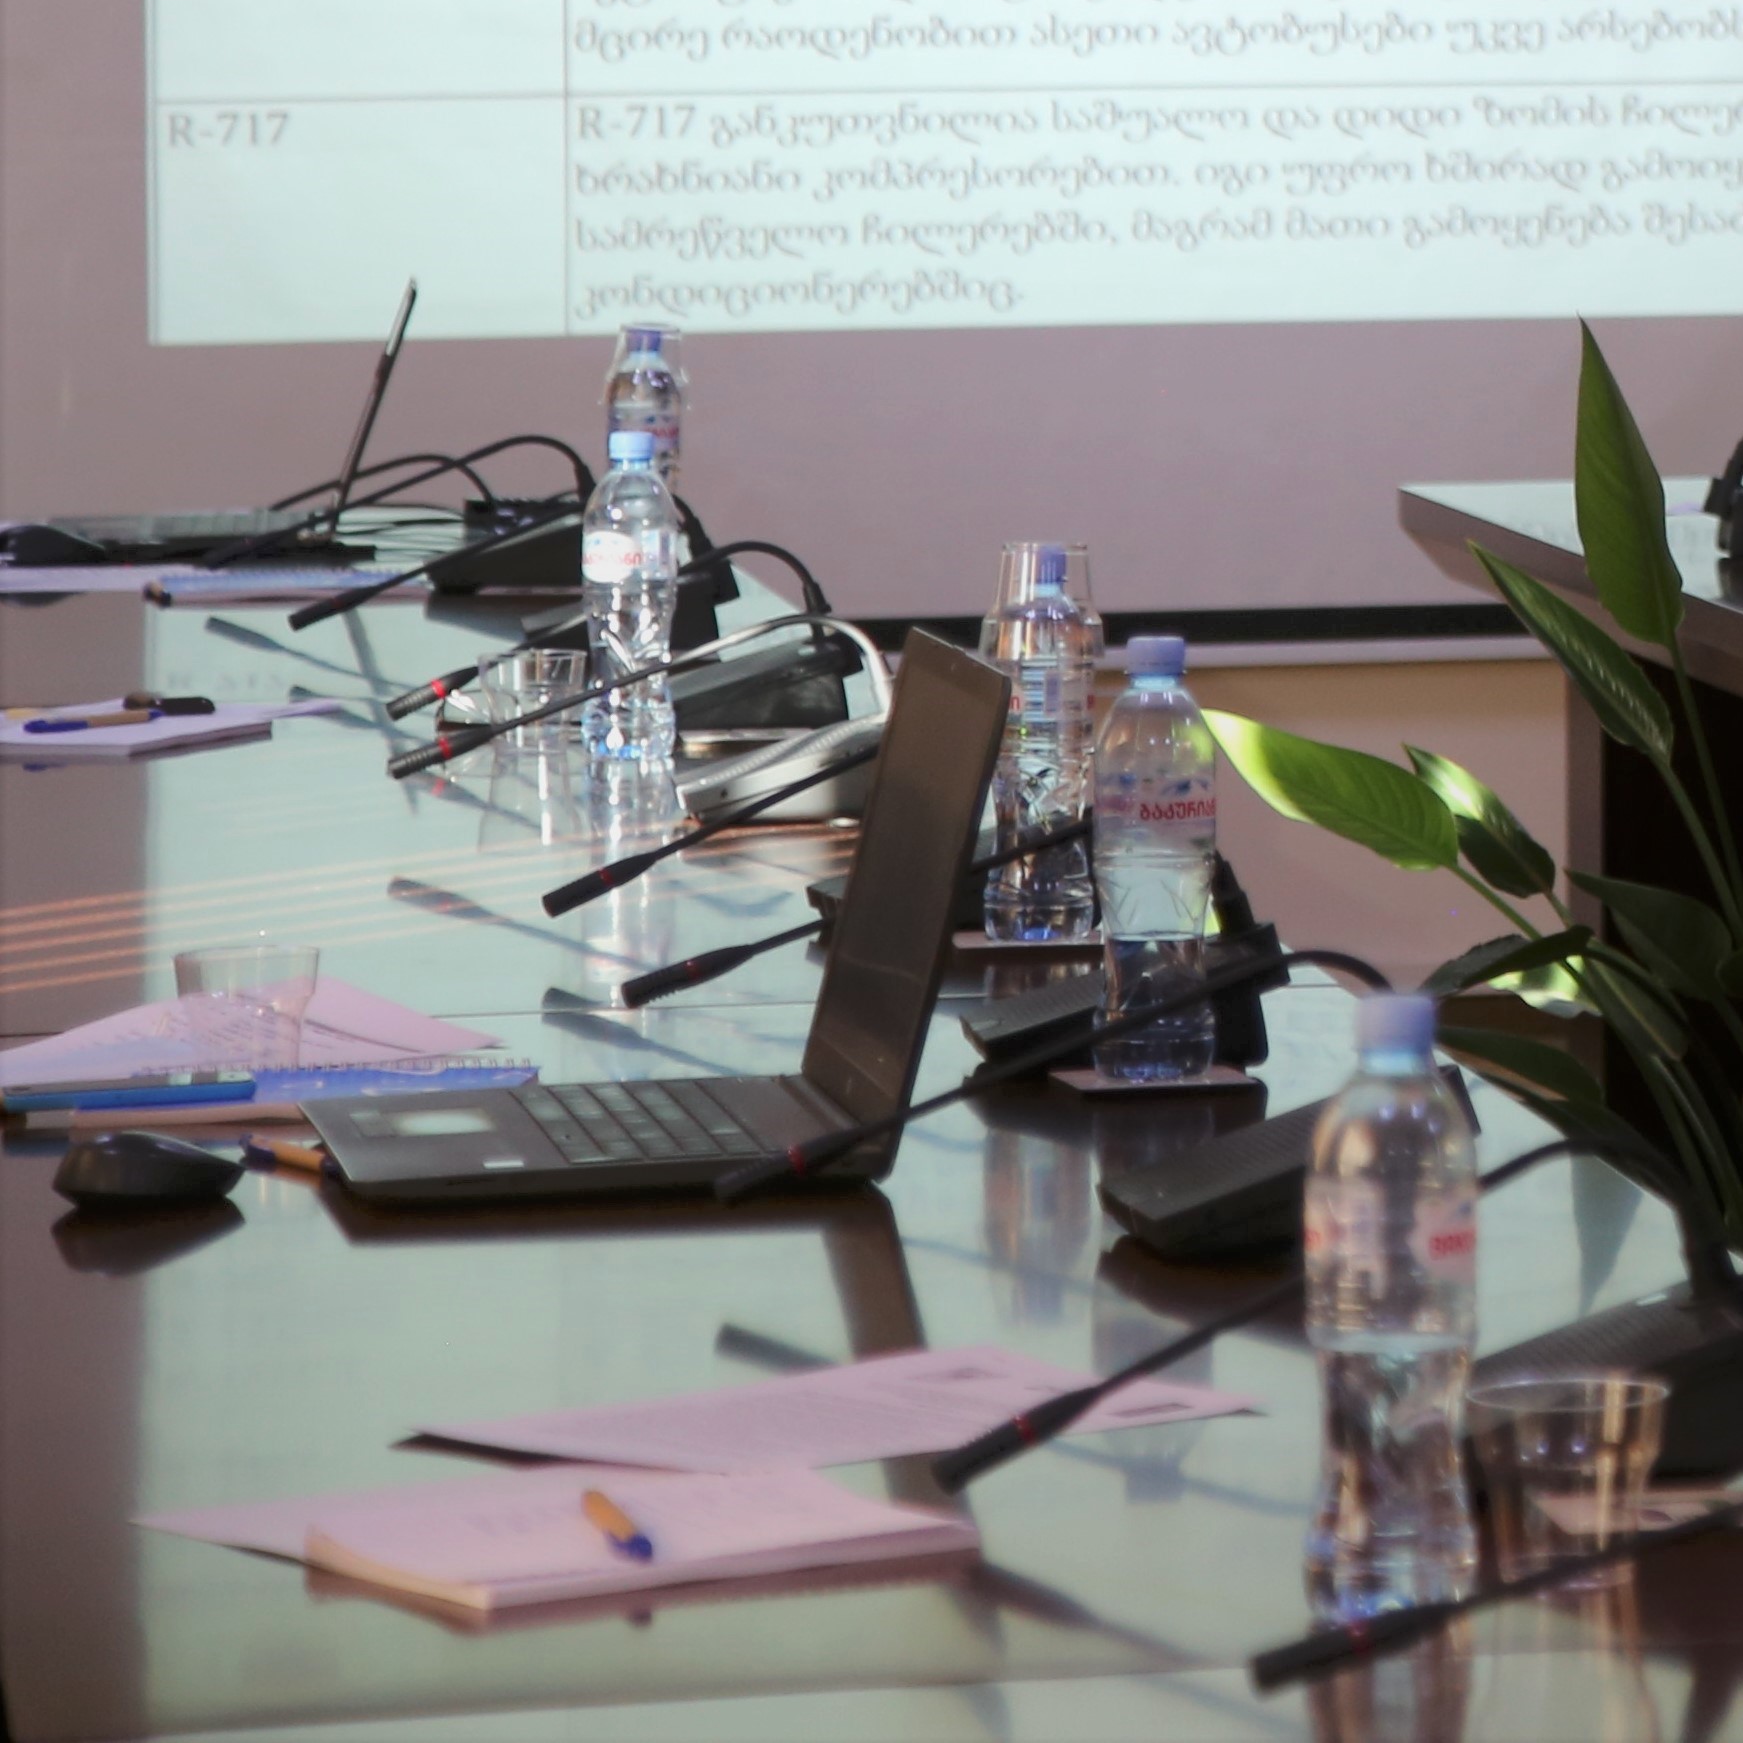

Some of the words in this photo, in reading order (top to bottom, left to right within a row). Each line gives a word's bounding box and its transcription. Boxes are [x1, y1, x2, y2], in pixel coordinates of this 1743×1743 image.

[573, 18, 711, 63] მცირე
[721, 15, 1018, 60] რაოდენობით
[1030, 13, 1160, 57] ასეთი
[1172, 10, 1435, 55] ავტობუსები
[1446, 20, 1547, 53] უკვე
[169, 110, 290, 147] R-717
[578, 103, 697, 140] R-717
[710, 102, 1039, 148] განკუთვნილია
[1051, 99, 1250, 142] საშუალო
[1262, 107, 1321, 141] და
[1333, 106, 1463, 140] დიდი
[1472, 94, 1612, 127] ზომის
[575, 159, 802, 195] ხრახნიანი
[1194, 163, 1271, 196] იგი
[1282, 153, 1414, 195] უფრო
[1425, 151, 1590, 193] ხშირად
[575, 215, 850, 261] სამრეწველო
[1131, 208, 1274, 251] მაგრამ
[1285, 207, 1392, 238] მათი
[1403, 203, 1632, 249] გამოყენება
